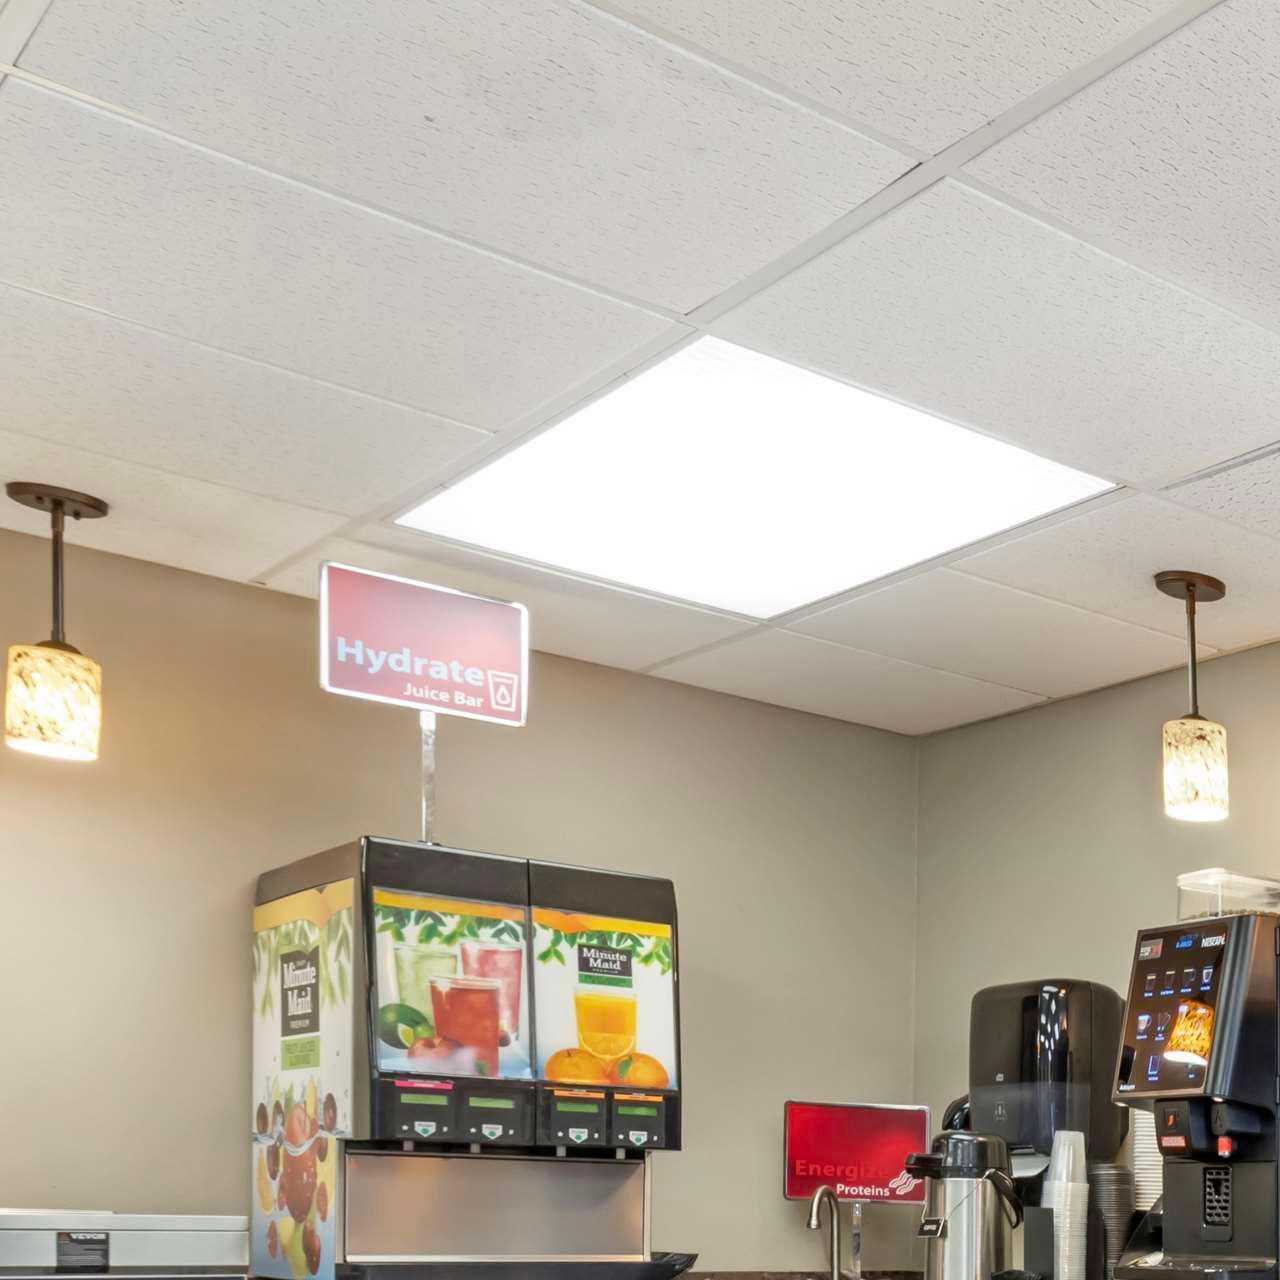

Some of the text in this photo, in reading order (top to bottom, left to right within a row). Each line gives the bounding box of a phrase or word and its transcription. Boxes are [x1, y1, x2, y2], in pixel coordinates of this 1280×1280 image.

[336, 636, 485, 687] Hydrate
[404, 683, 484, 708] Juice Bar
[583, 947, 627, 961] Minute
[589, 957, 621, 971] Maid
[283, 960, 317, 989] Minute
[288, 986, 312, 1016] Maid
[836, 1183, 890, 1197] Proteins
